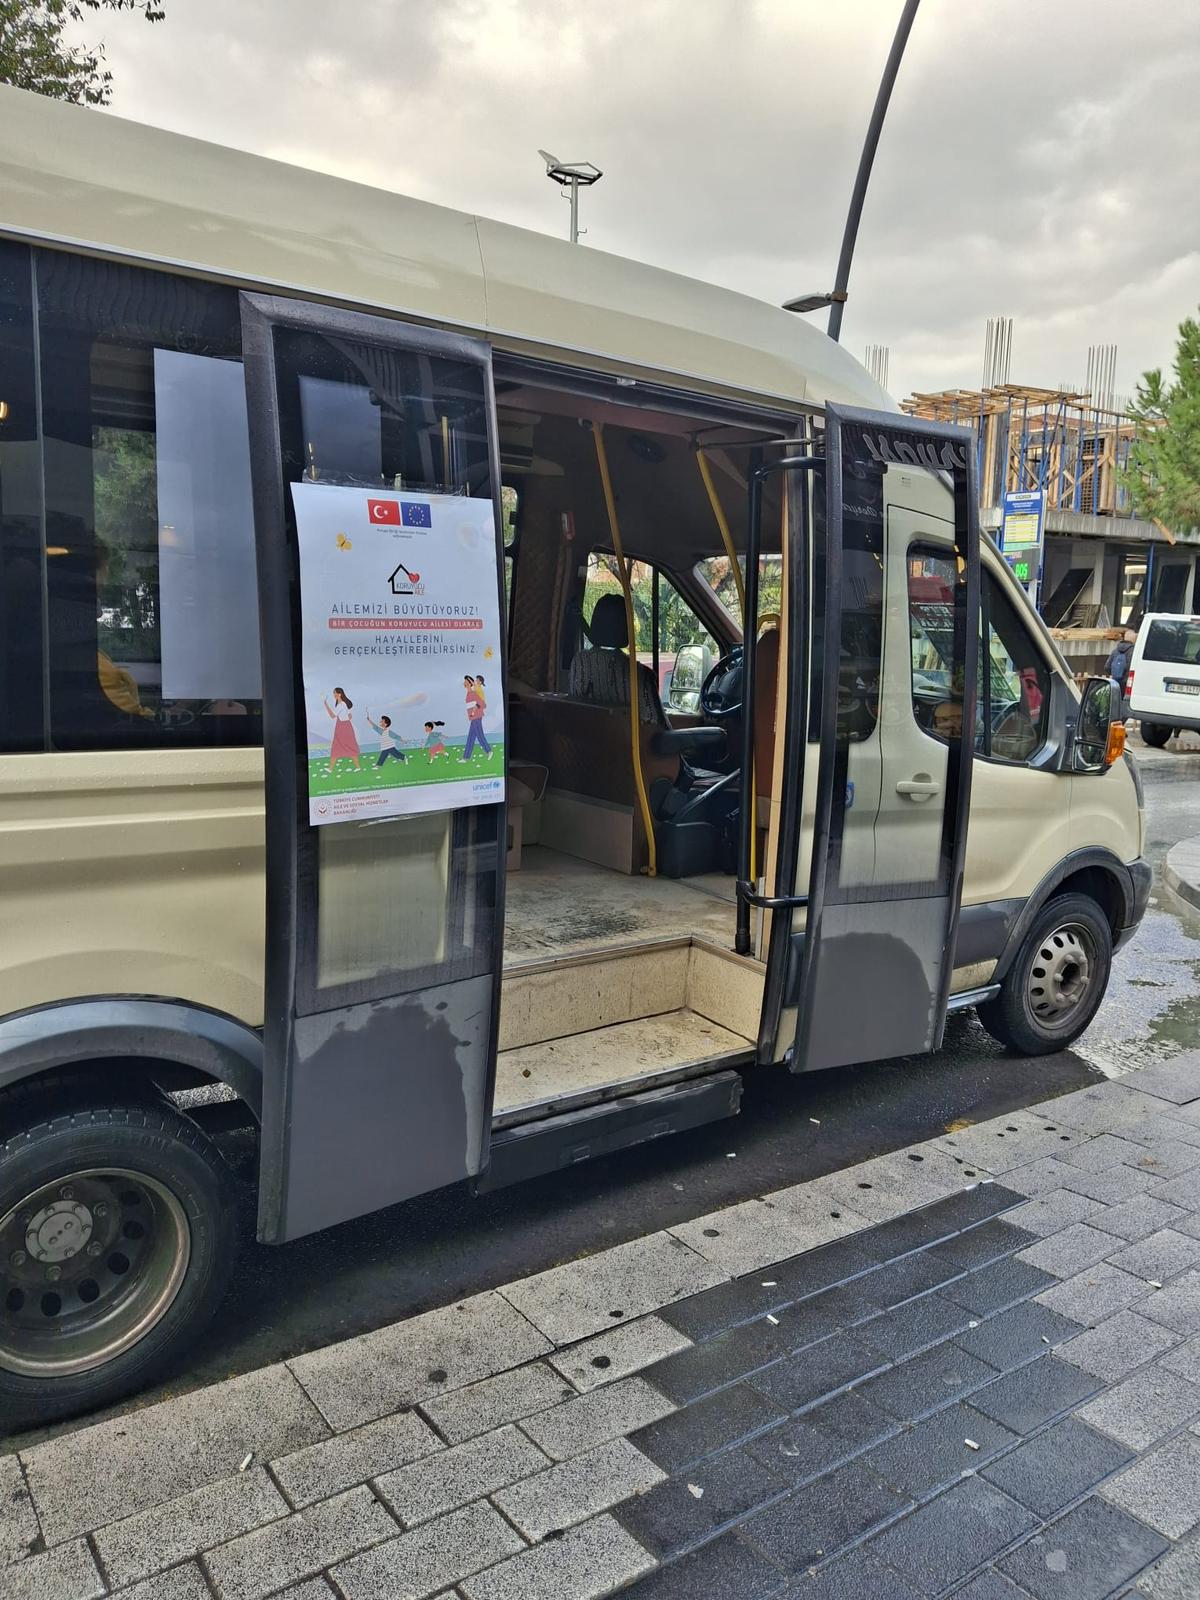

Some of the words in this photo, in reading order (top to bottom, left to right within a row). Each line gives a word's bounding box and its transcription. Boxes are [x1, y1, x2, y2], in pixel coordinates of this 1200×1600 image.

[332, 602, 387, 614] AİLEMİZİ
[394, 603, 478, 615] BÜYÜTÜYORUZ!
[349, 620, 386, 628] ÇOCUĞUN
[388, 620, 427, 628] KORUYUCU
[430, 620, 452, 628] AİLESİ
[375, 633, 443, 644] HAYALLERİNİ
